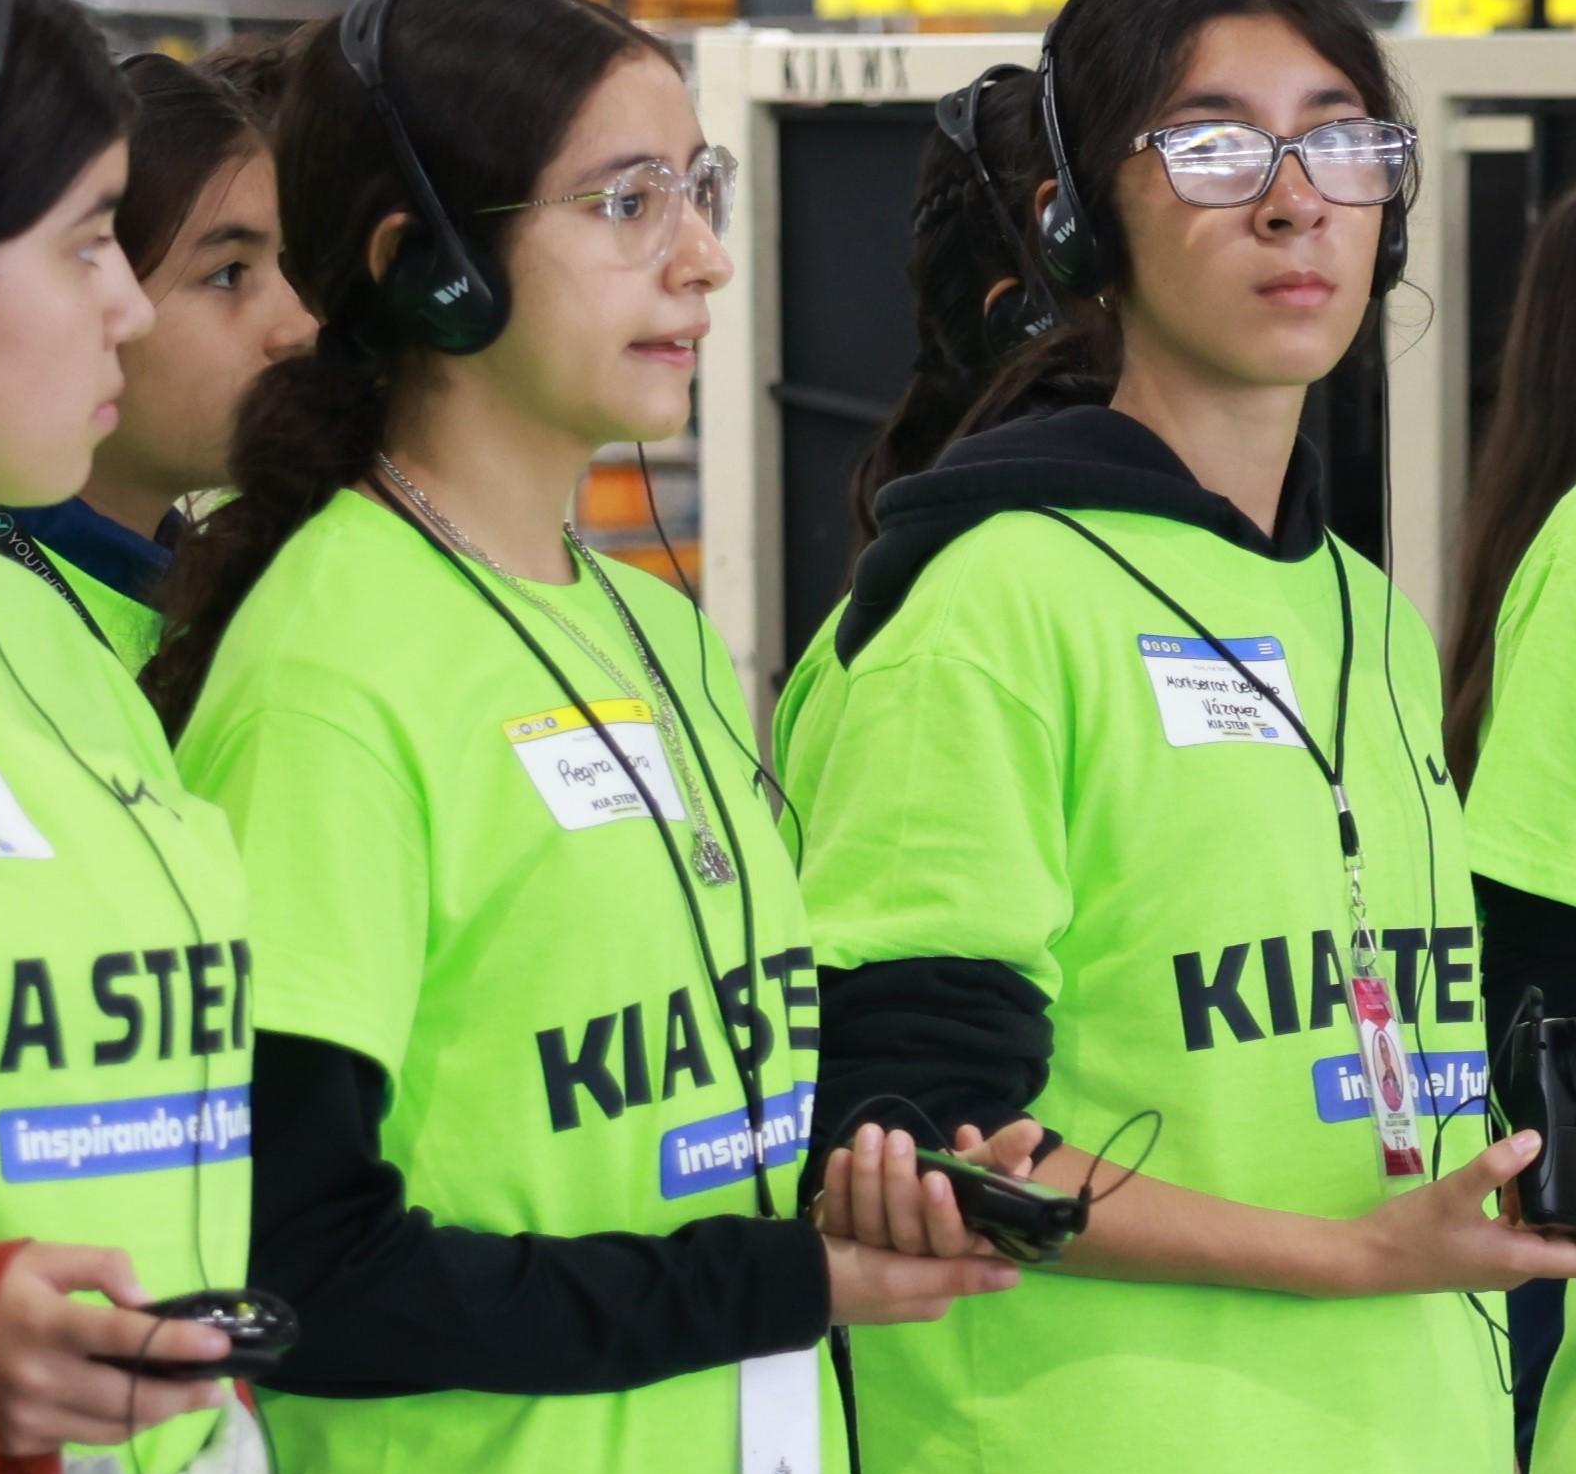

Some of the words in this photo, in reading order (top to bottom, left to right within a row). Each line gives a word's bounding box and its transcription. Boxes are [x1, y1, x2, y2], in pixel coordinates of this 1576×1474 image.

[782, 47, 844, 93] KIA
[1166, 675, 1230, 692] Montserrat
[1207, 719, 1226, 730] KIA
[1226, 719, 1251, 731] STEM
[534, 986, 716, 1134] KIA
[16, 1108, 184, 1168] inspirando
